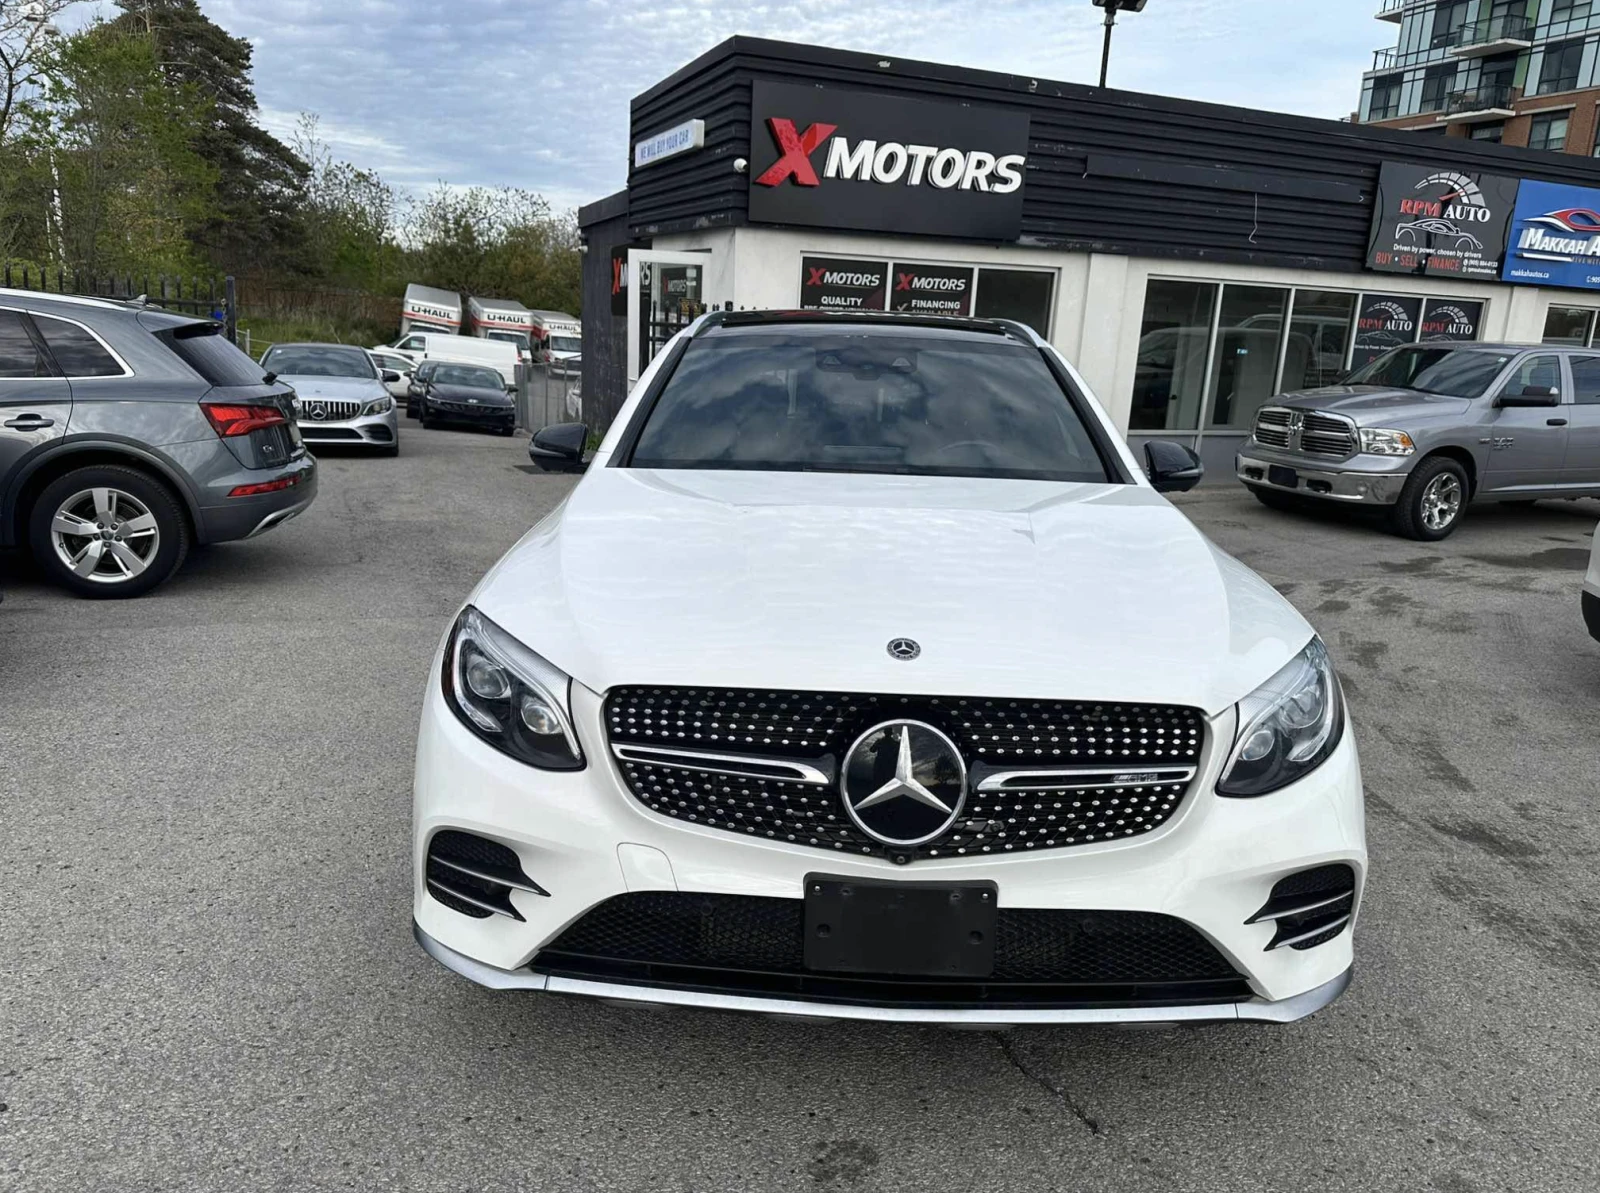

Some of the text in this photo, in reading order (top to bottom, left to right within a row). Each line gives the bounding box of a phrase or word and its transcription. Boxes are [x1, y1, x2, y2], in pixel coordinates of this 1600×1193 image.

[754, 117, 1026, 194] X MOTORS
[1400, 199, 1491, 222] RPM AUTO
[1517, 227, 1588, 256] MAKKAH
[1393, 243, 1411, 252] Driven
[1411, 245, 1418, 254] by
[1437, 249, 1456, 257] chosen
[1456, 250, 1463, 258] by
[1463, 251, 1482, 259] drivers
[1375, 251, 1460, 272] BUY SELL FINANCE
[806, 267, 881, 287] X MOTORS
[895, 272, 966, 291] X MOTORS
[821, 295, 863, 307] QUALITY
[911, 299, 961, 310] FINANCING
[411, 305, 453, 320] U-HAUL
[487, 313, 527, 324] U-HAUL
[1358, 317, 1413, 332] RPM AUTO
[1421, 321, 1473, 335] RPM AUTO
